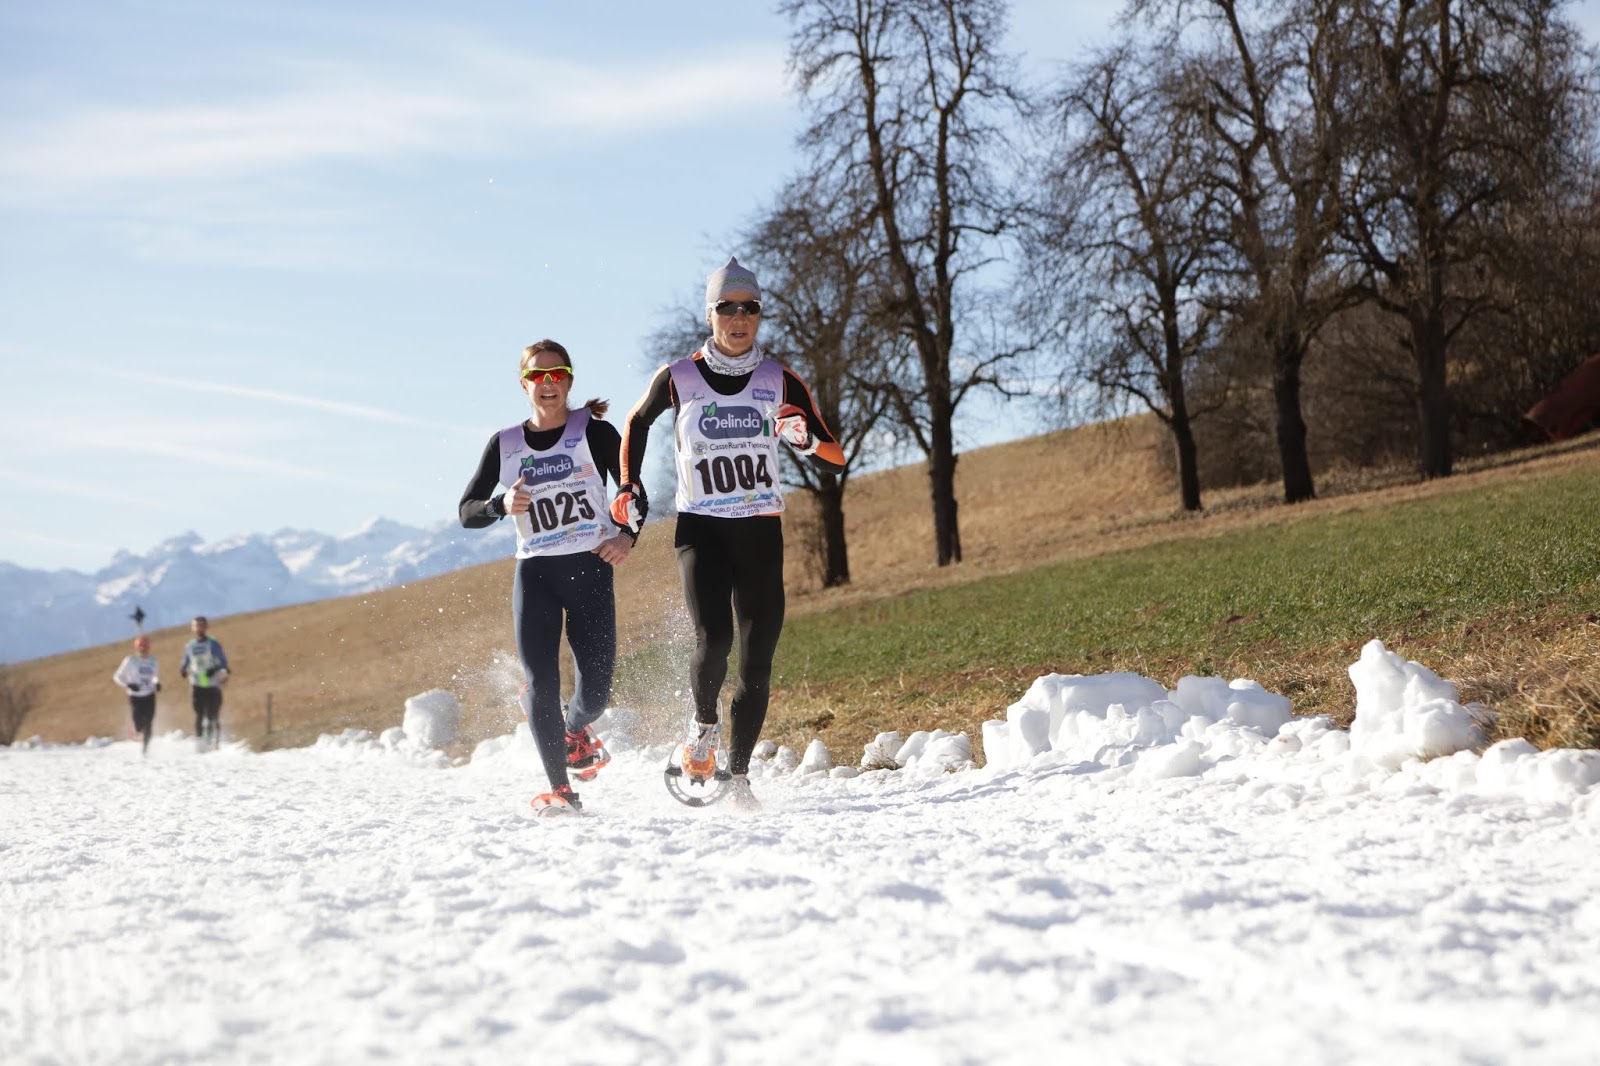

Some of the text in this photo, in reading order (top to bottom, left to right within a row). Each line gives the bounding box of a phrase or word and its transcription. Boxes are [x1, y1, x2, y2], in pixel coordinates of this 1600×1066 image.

[701, 412, 760, 431] Melinda
[520, 459, 572, 478] Melinda
[694, 453, 773, 495] 1004
[525, 489, 596, 534] 1025
